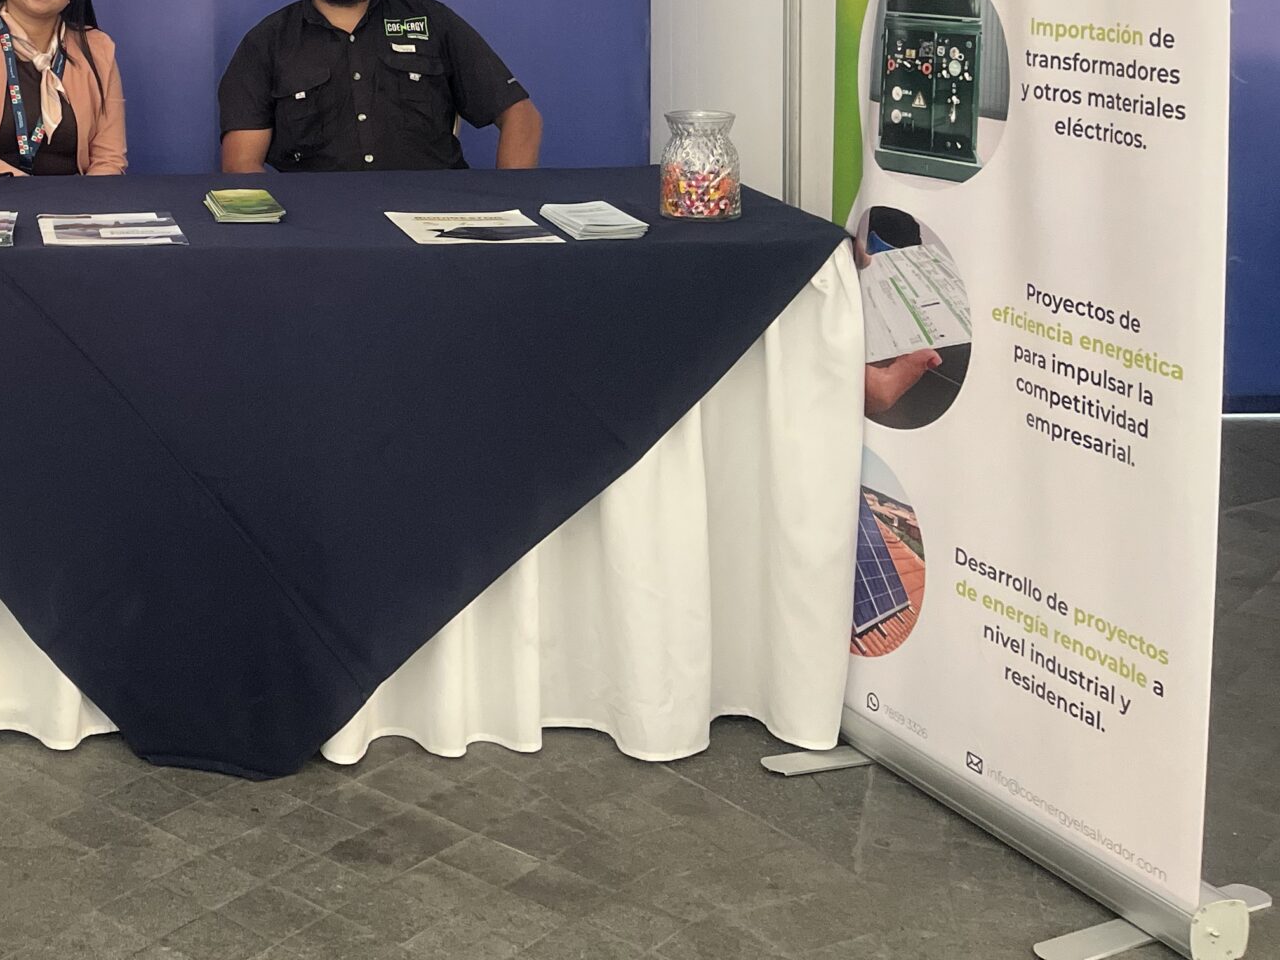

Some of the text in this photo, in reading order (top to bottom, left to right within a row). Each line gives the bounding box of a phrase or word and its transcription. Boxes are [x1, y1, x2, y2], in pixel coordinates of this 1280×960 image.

[386, 19, 425, 33] COENERGY
[1029, 16, 1175, 50] Importación de
[1025, 49, 1181, 85] transformadores
[1021, 82, 1187, 121] y otros materiales
[1054, 115, 1147, 150] eléctricos.
[1025, 282, 1142, 334] Proyectos de
[991, 304, 1185, 381] eficiencia energética
[1014, 342, 1154, 407] para impulsar la
[1016, 377, 1149, 440] competitividad
[1025, 411, 1136, 468] empresarial.
[954, 545, 1169, 667] Desarrollo de proyectos
[955, 578, 1164, 698] de energía renovable a
[983, 622, 1131, 715] nivel industrial y
[1004, 665, 1106, 734] residencial.
